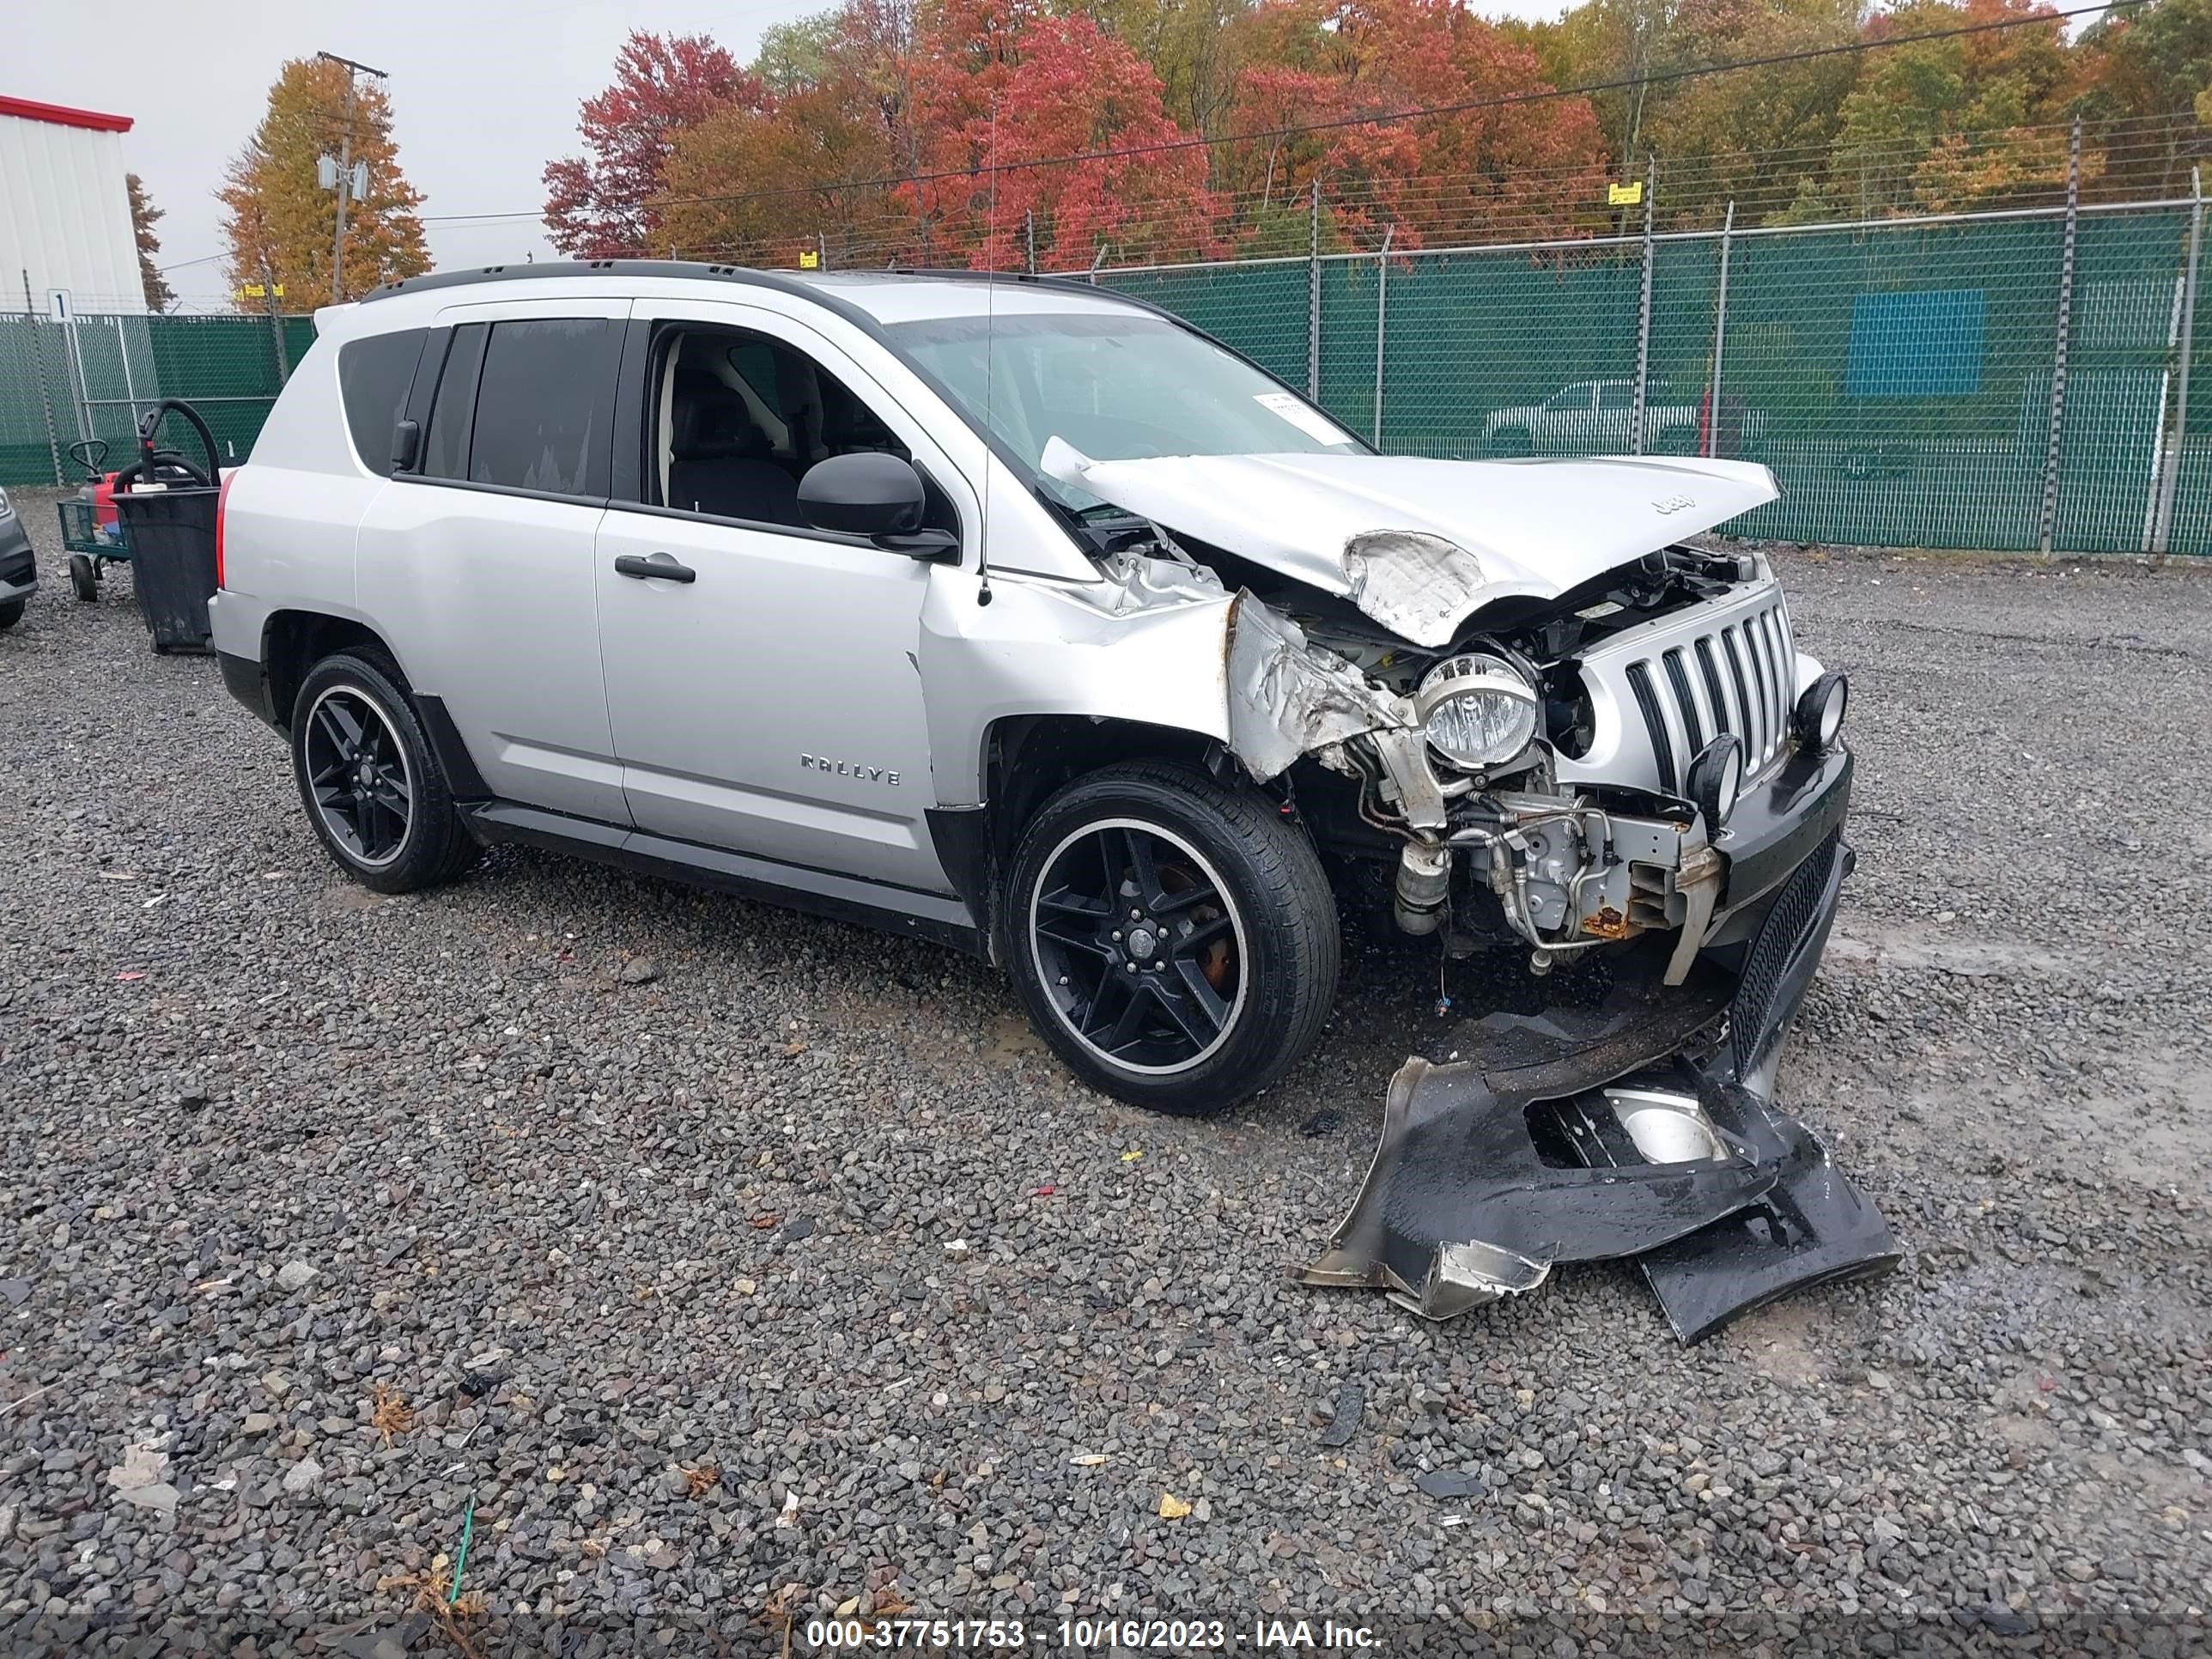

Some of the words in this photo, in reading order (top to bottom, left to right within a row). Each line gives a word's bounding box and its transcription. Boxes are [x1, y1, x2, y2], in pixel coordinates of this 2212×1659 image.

[56, 294, 64, 318] 1
[1650, 494, 1697, 515] Jeep
[800, 752, 901, 787] RALLYE
